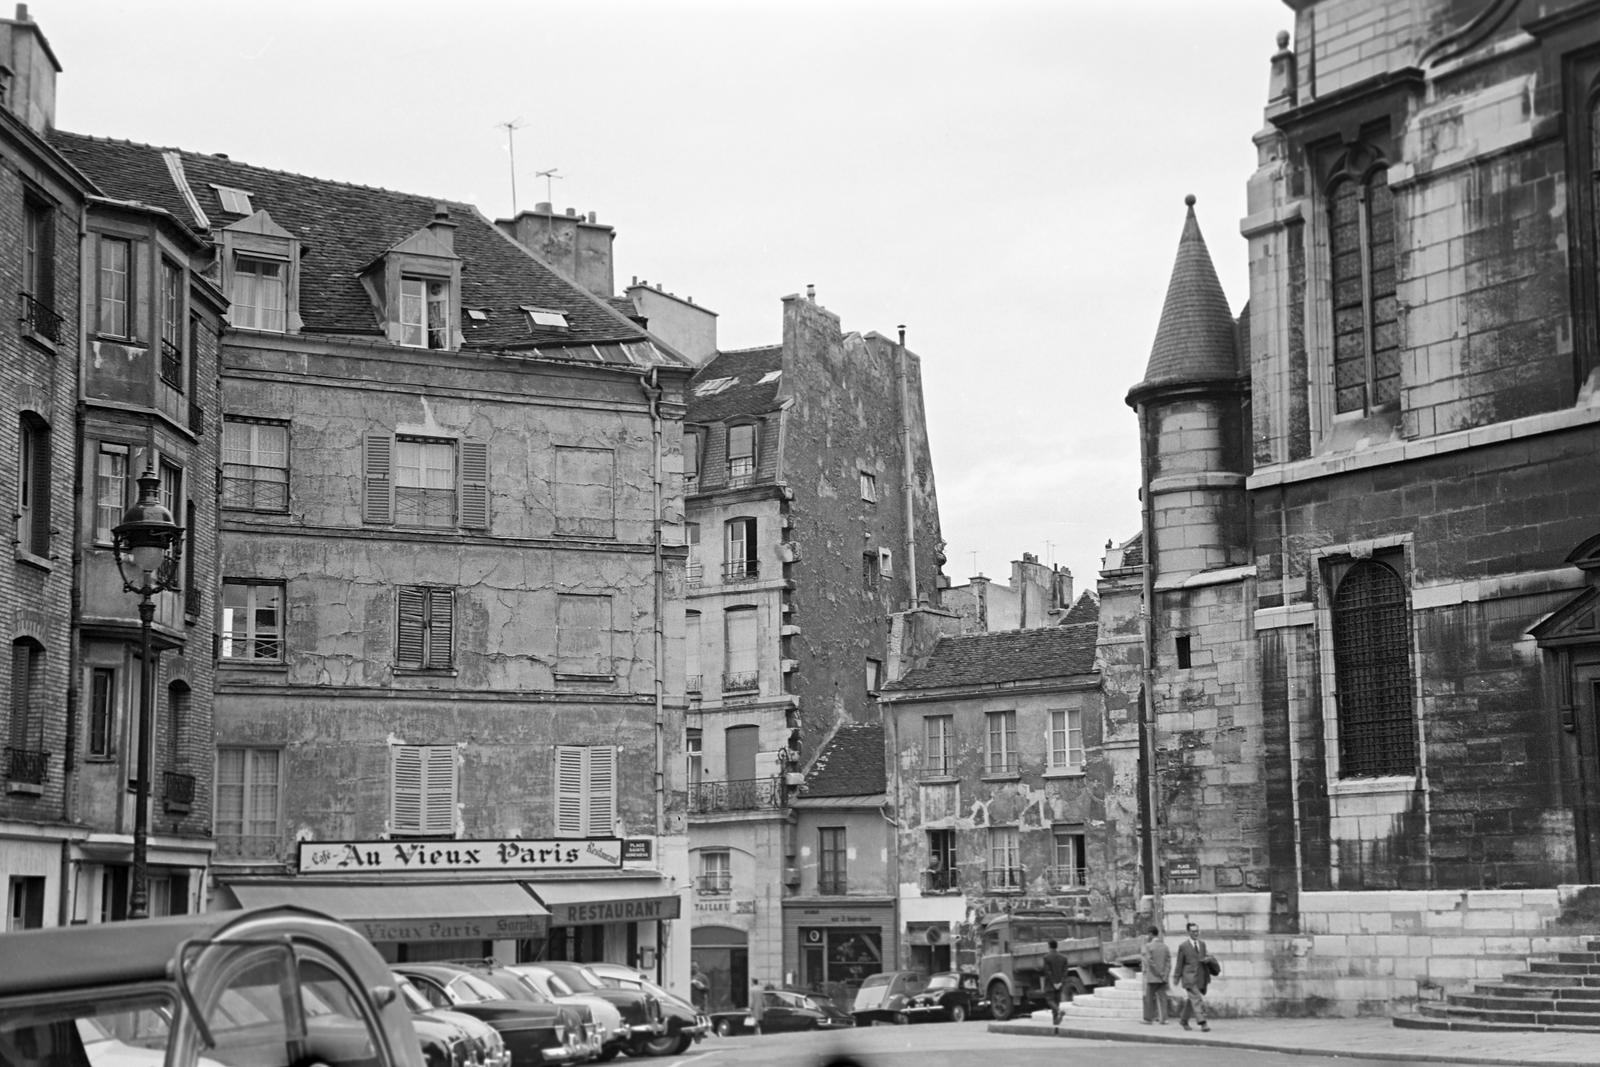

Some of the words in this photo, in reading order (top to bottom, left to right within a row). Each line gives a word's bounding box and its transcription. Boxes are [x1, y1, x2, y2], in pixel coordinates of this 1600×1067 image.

[336, 844, 382, 867] Au
[394, 844, 481, 866] Vieux
[497, 842, 580, 864] Paris
[567, 901, 662, 921] RESTAURANT
[364, 923, 422, 940] Vieux
[428, 921, 481, 938] Paris
